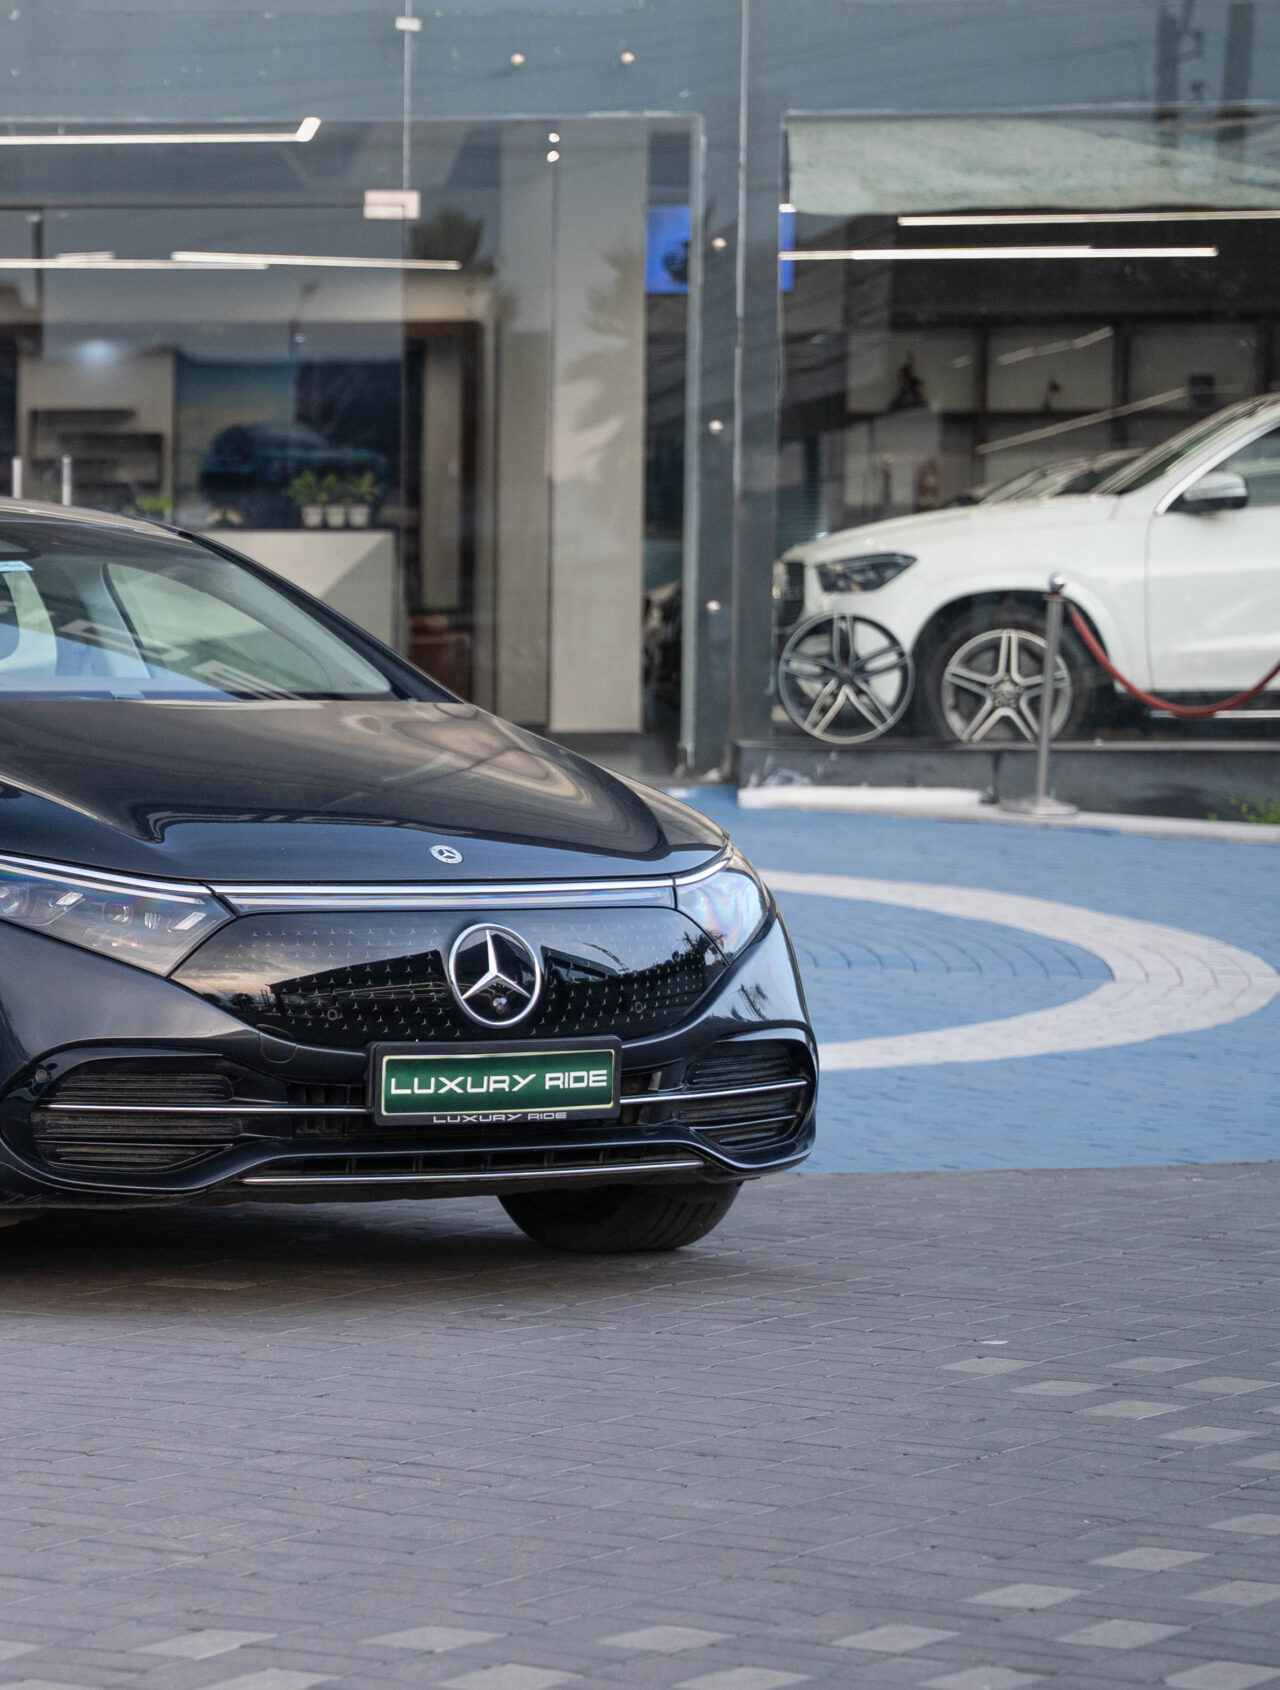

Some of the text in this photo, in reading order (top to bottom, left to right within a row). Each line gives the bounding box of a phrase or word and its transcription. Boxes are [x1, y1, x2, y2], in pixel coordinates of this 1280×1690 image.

[390, 1069, 608, 1095] LUXURY RIDE
[433, 1111, 567, 1123] LUXURY RIDE
